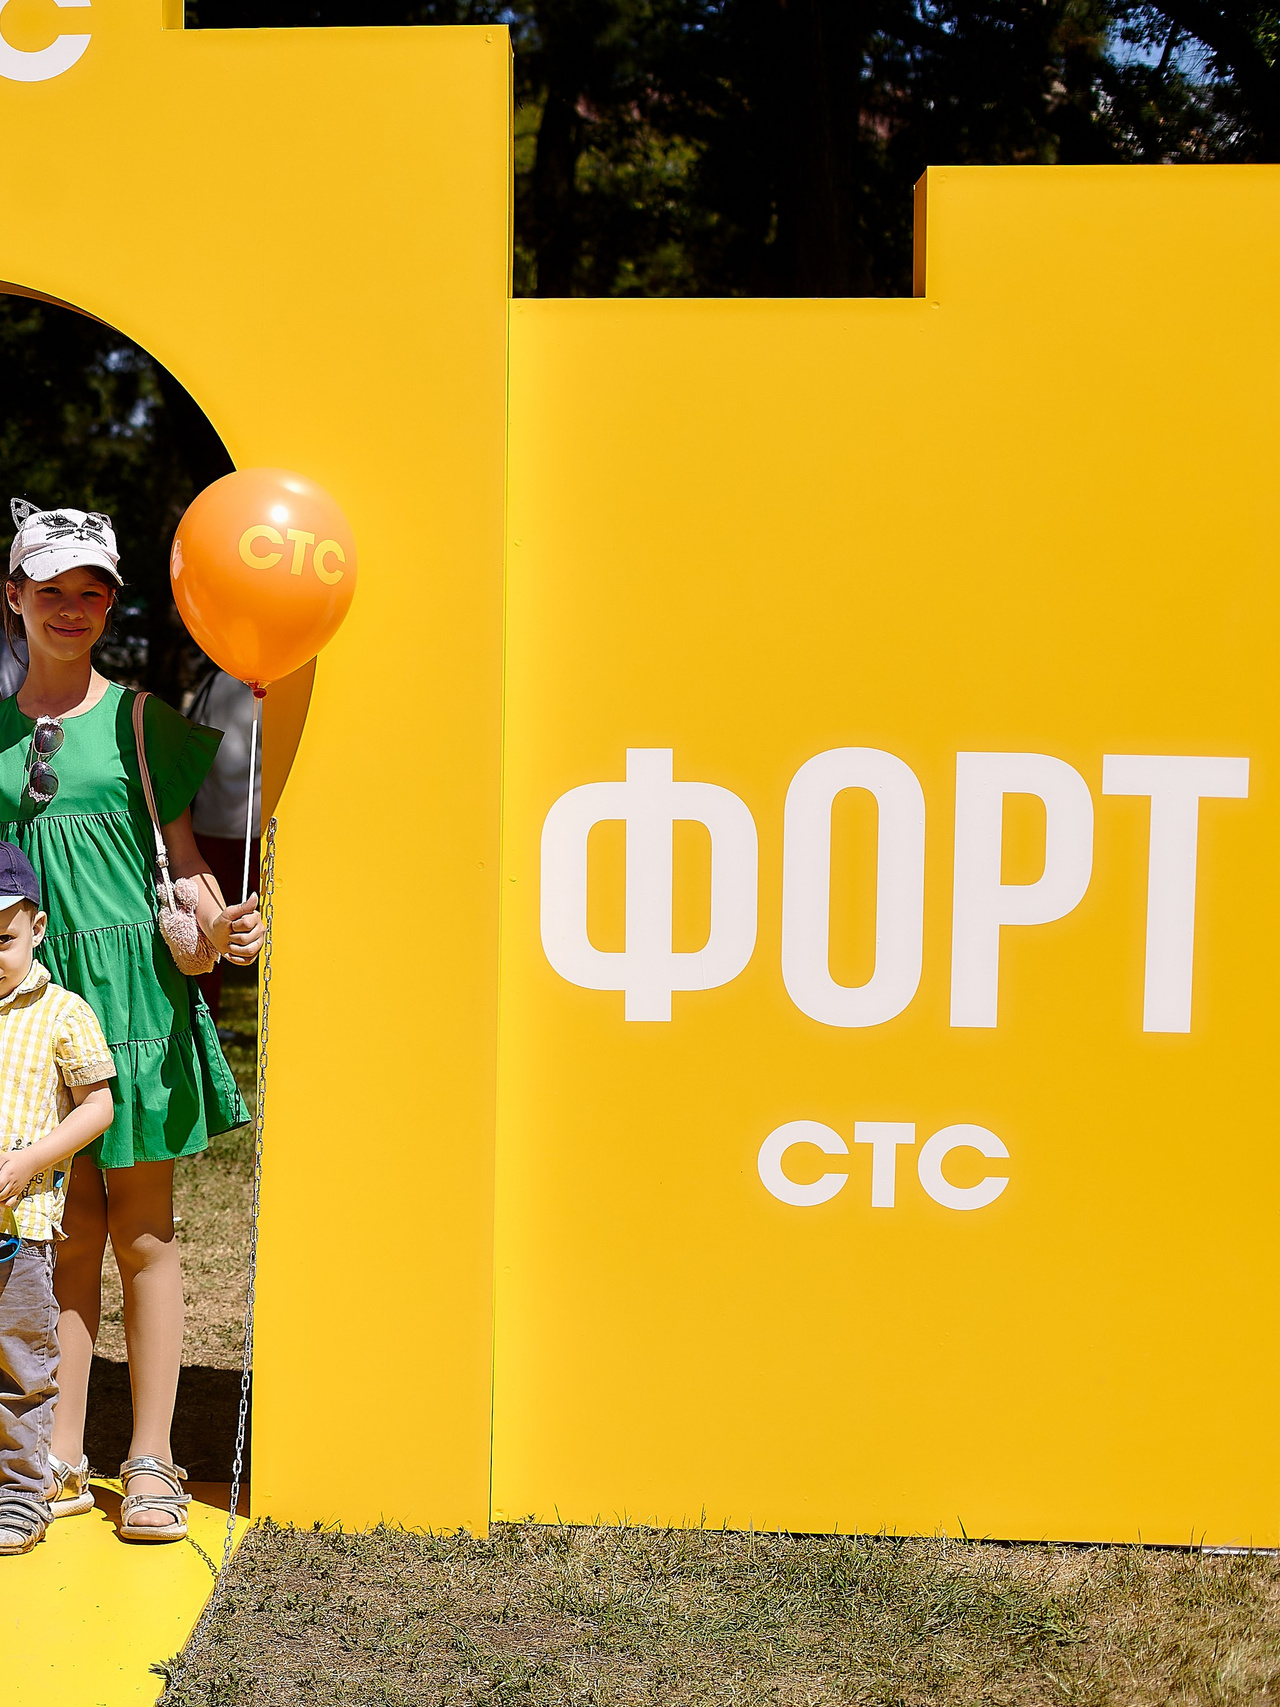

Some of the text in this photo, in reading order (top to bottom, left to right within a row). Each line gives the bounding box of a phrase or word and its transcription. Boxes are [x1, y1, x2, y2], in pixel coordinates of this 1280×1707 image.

[238, 524, 346, 586] СТС
[539, 746, 1250, 1034] ФОРТ
[757, 1119, 1010, 1212] СТС
